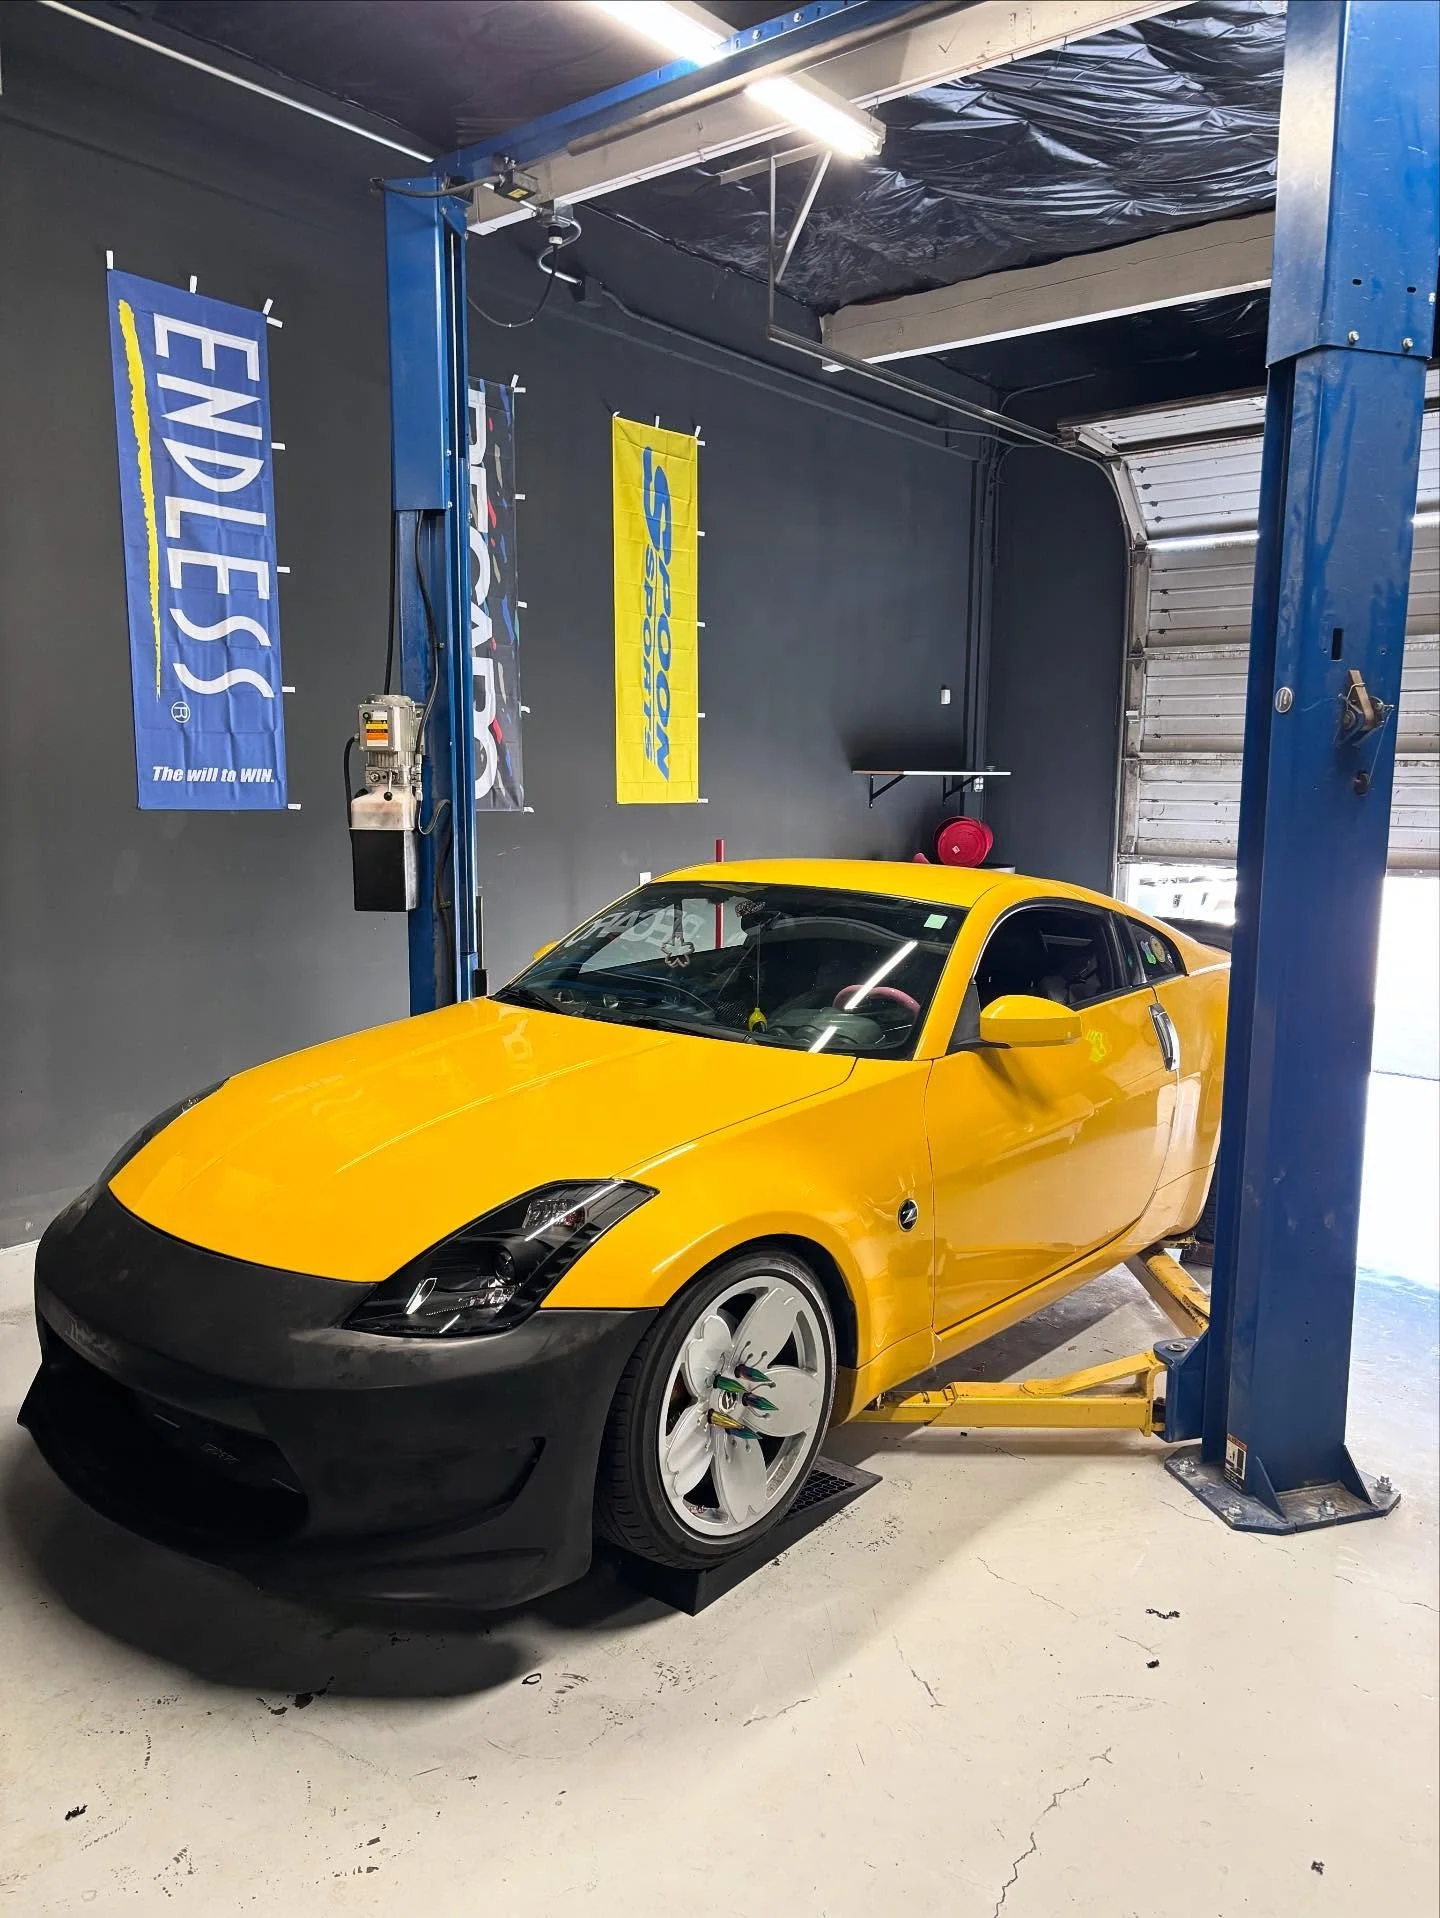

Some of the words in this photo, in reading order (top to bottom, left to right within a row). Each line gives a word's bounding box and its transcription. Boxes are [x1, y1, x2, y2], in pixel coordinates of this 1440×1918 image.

[152, 312, 275, 698] ENDLESS
[642, 446, 673, 782] SPOON
[152, 766, 184, 782] The
[186, 767, 219, 783] will
[220, 768, 237, 783] to
[240, 768, 275, 783] WIN.
[643, 543, 655, 763] SPORTS
